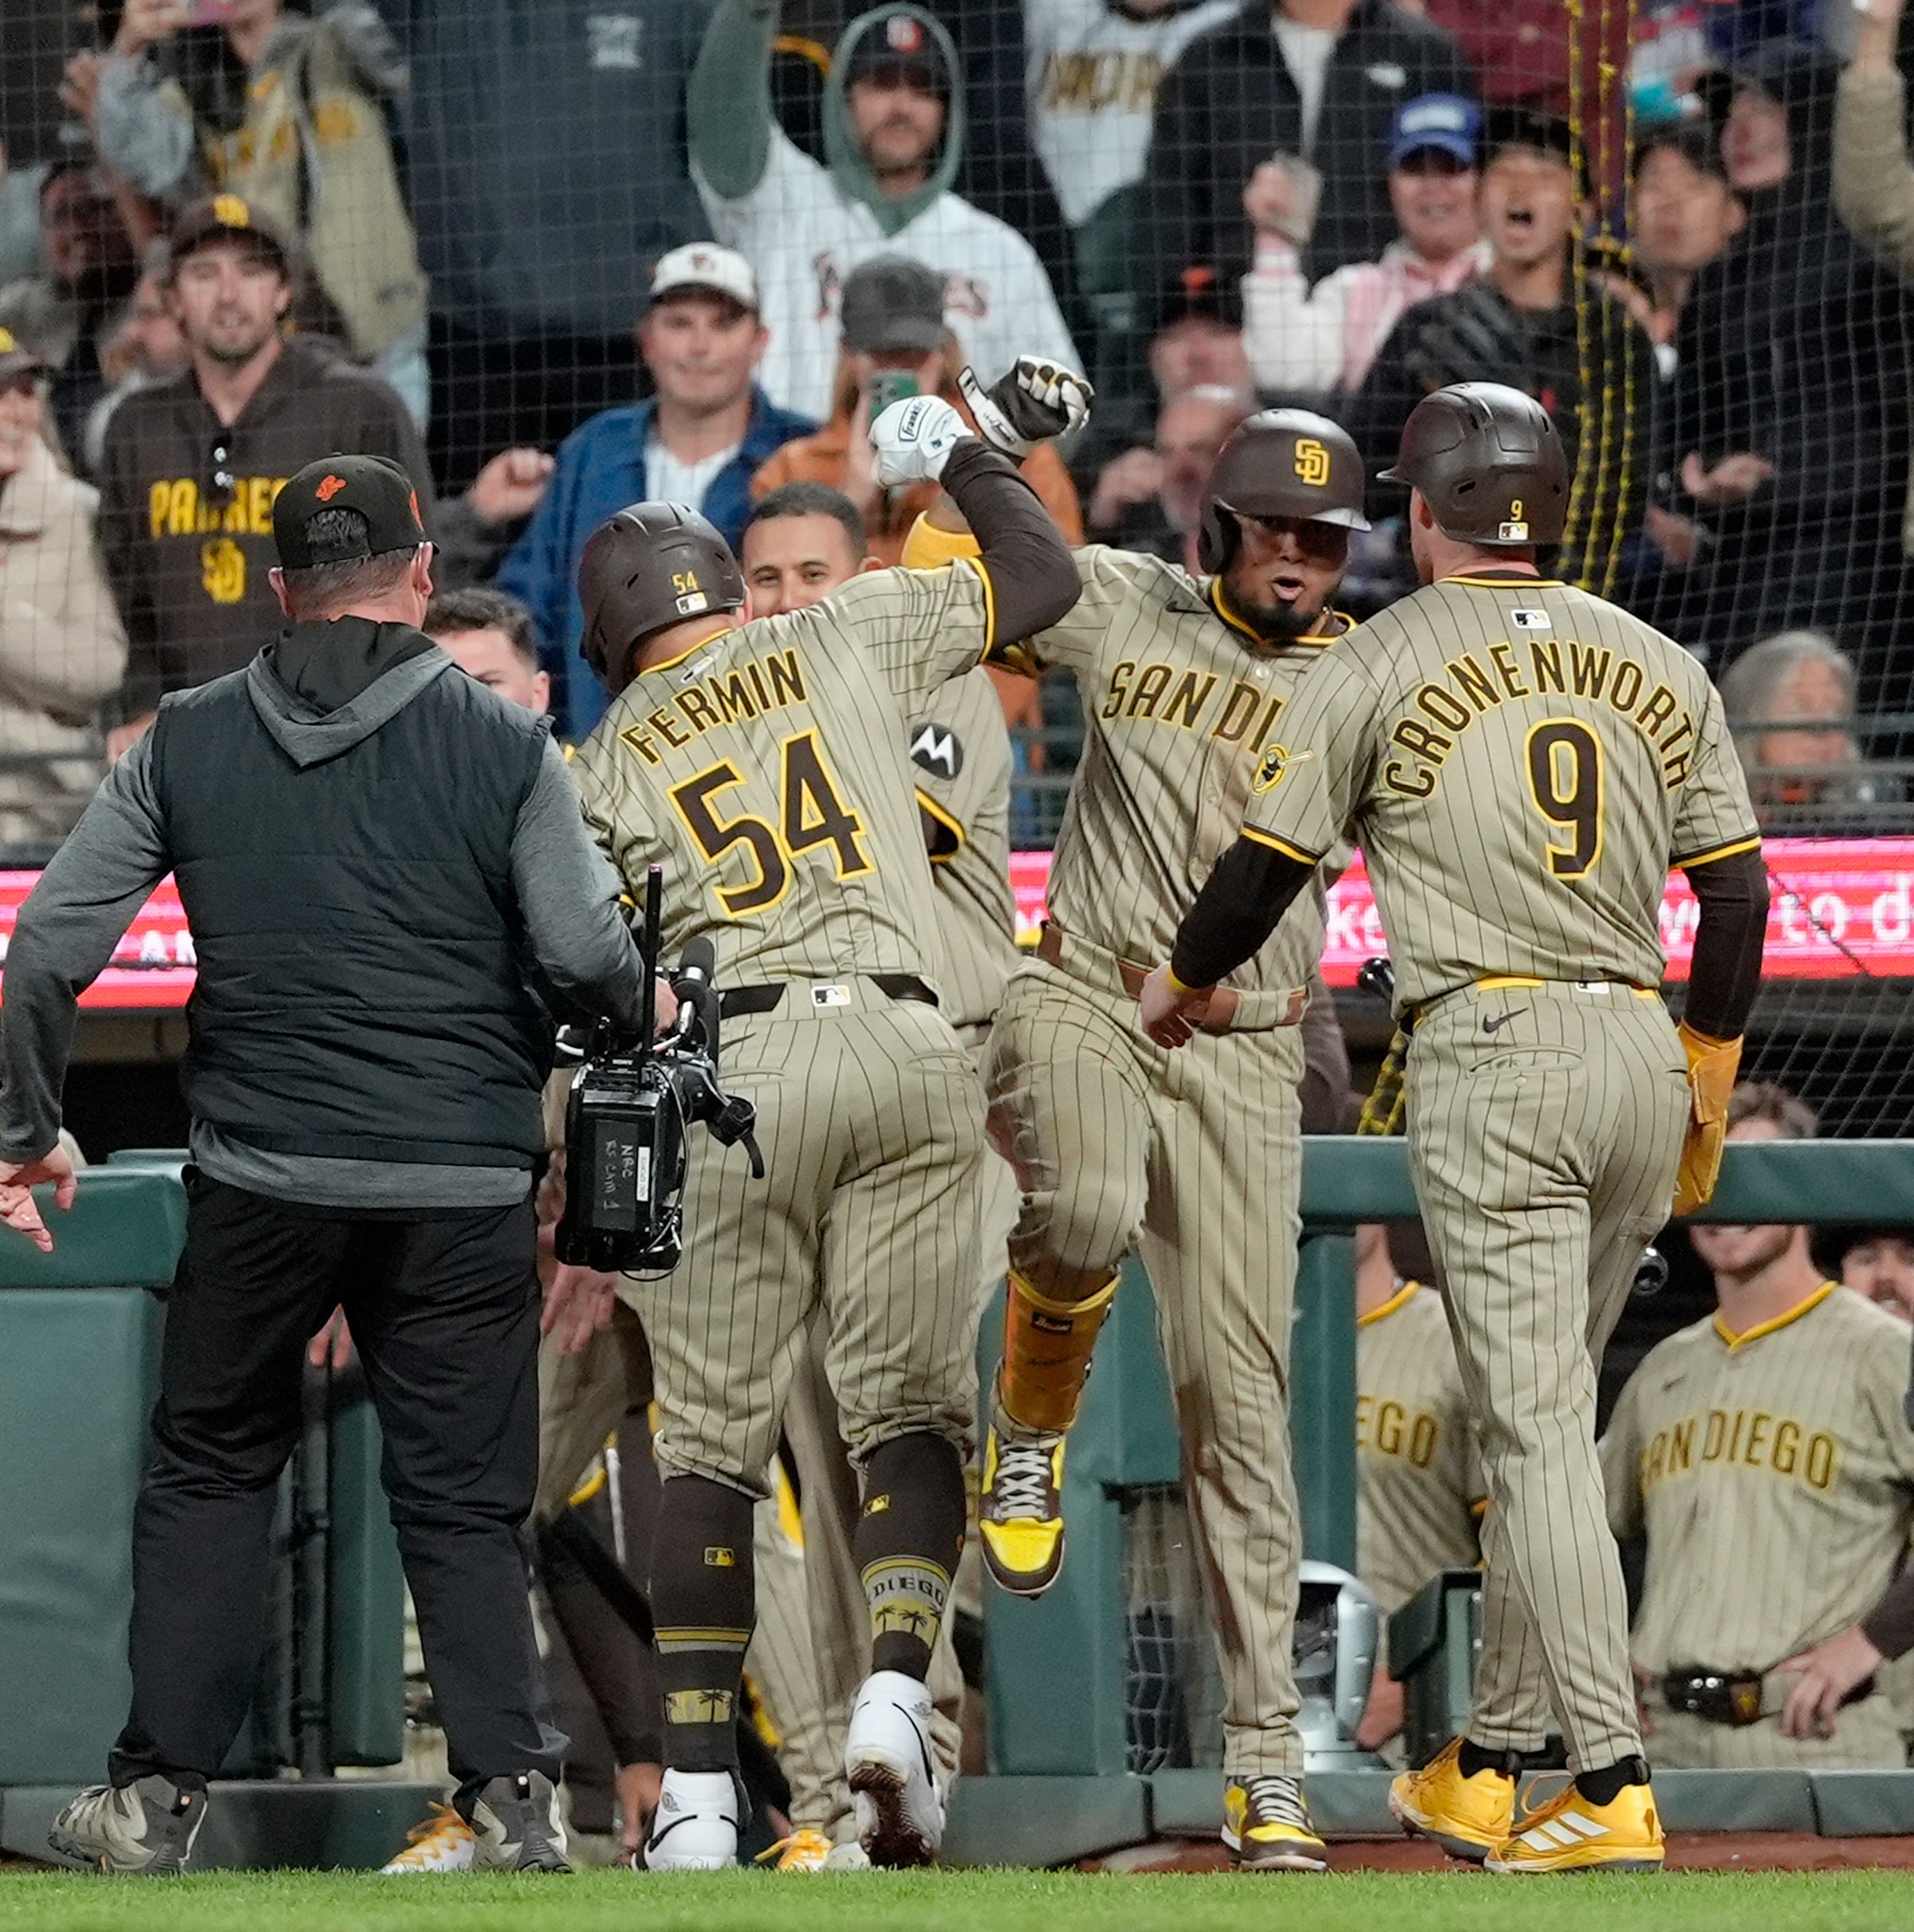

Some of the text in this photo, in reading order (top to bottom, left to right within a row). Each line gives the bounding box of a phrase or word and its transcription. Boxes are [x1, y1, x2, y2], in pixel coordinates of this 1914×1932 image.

[1295, 439, 1330, 487] SD
[149, 477, 289, 540] PARE
[1510, 500, 1523, 521] 9
[671, 569, 699, 595] 54
[617, 647, 809, 766] FERMIN
[1101, 659, 1219, 731] SAN
[1382, 639, 1696, 801] CRONENWORTH
[665, 726, 876, 919] 54
[1523, 715, 1605, 880] 9
[1777, 891, 1850, 946] to
[1641, 1407, 1837, 1493] AN DIEGO
[873, 1576, 945, 1607] DIEGO
